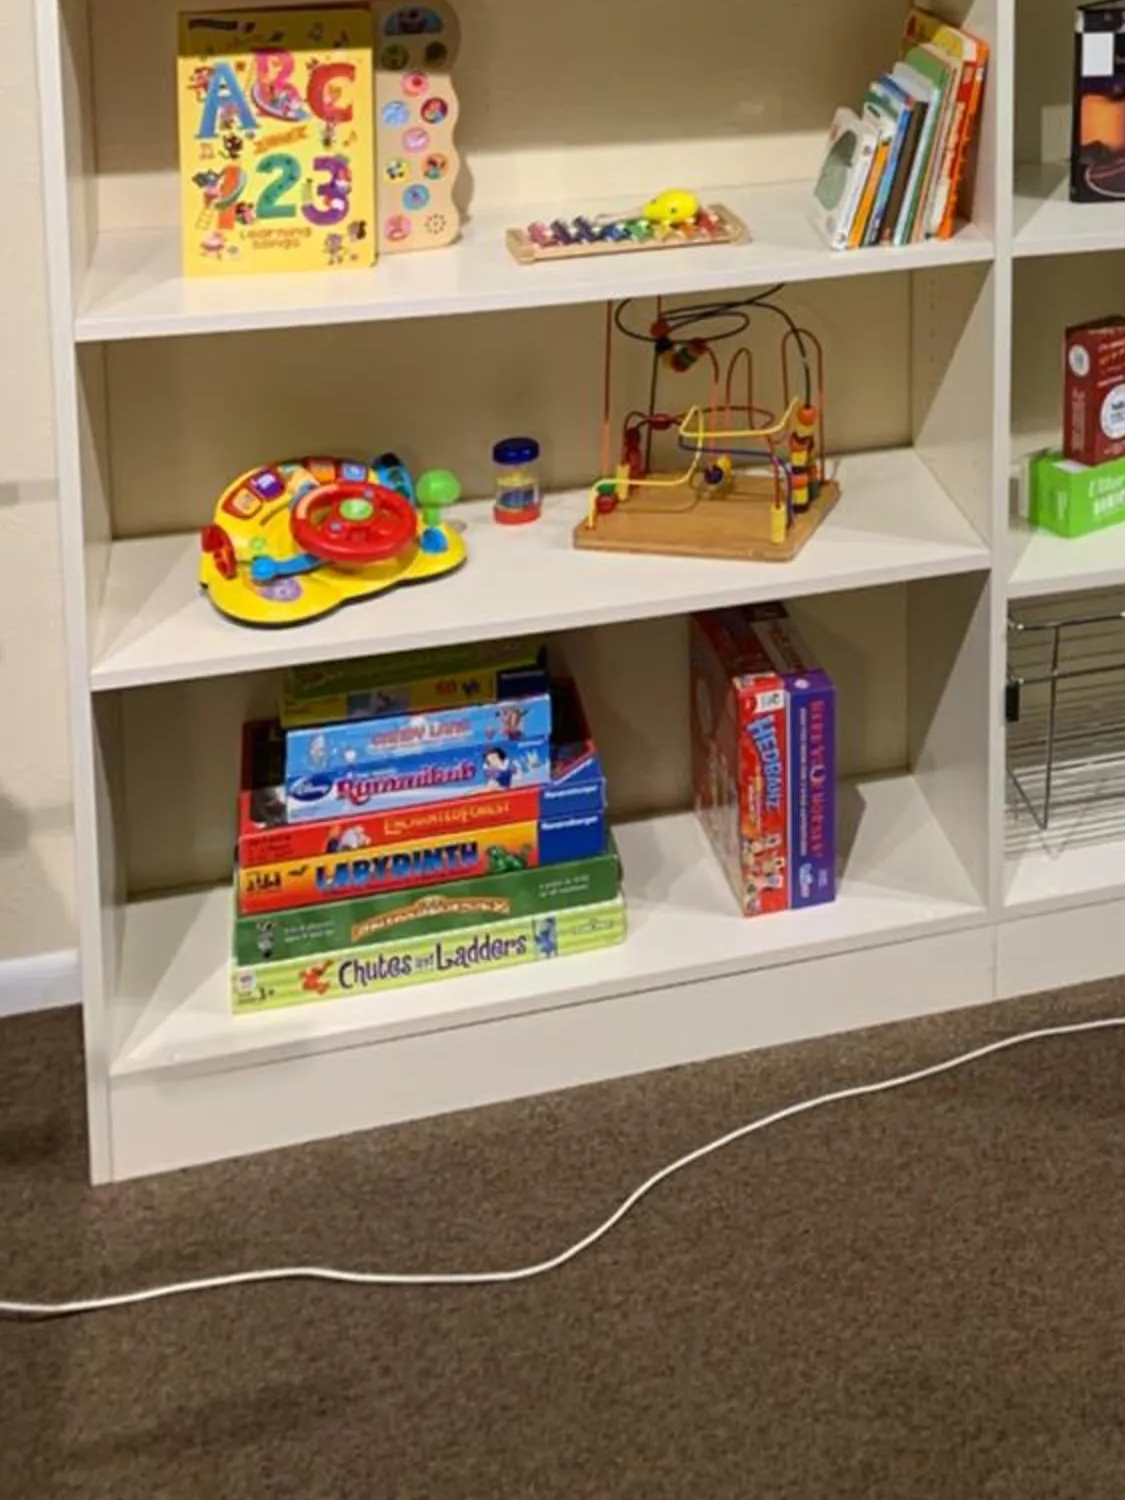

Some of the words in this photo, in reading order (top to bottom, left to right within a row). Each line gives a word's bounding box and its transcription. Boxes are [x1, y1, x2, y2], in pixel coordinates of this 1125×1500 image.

[315, 841, 478, 893] LABYRINTH
[339, 953, 413, 990] Chutes
[435, 932, 528, 972] Ladders
